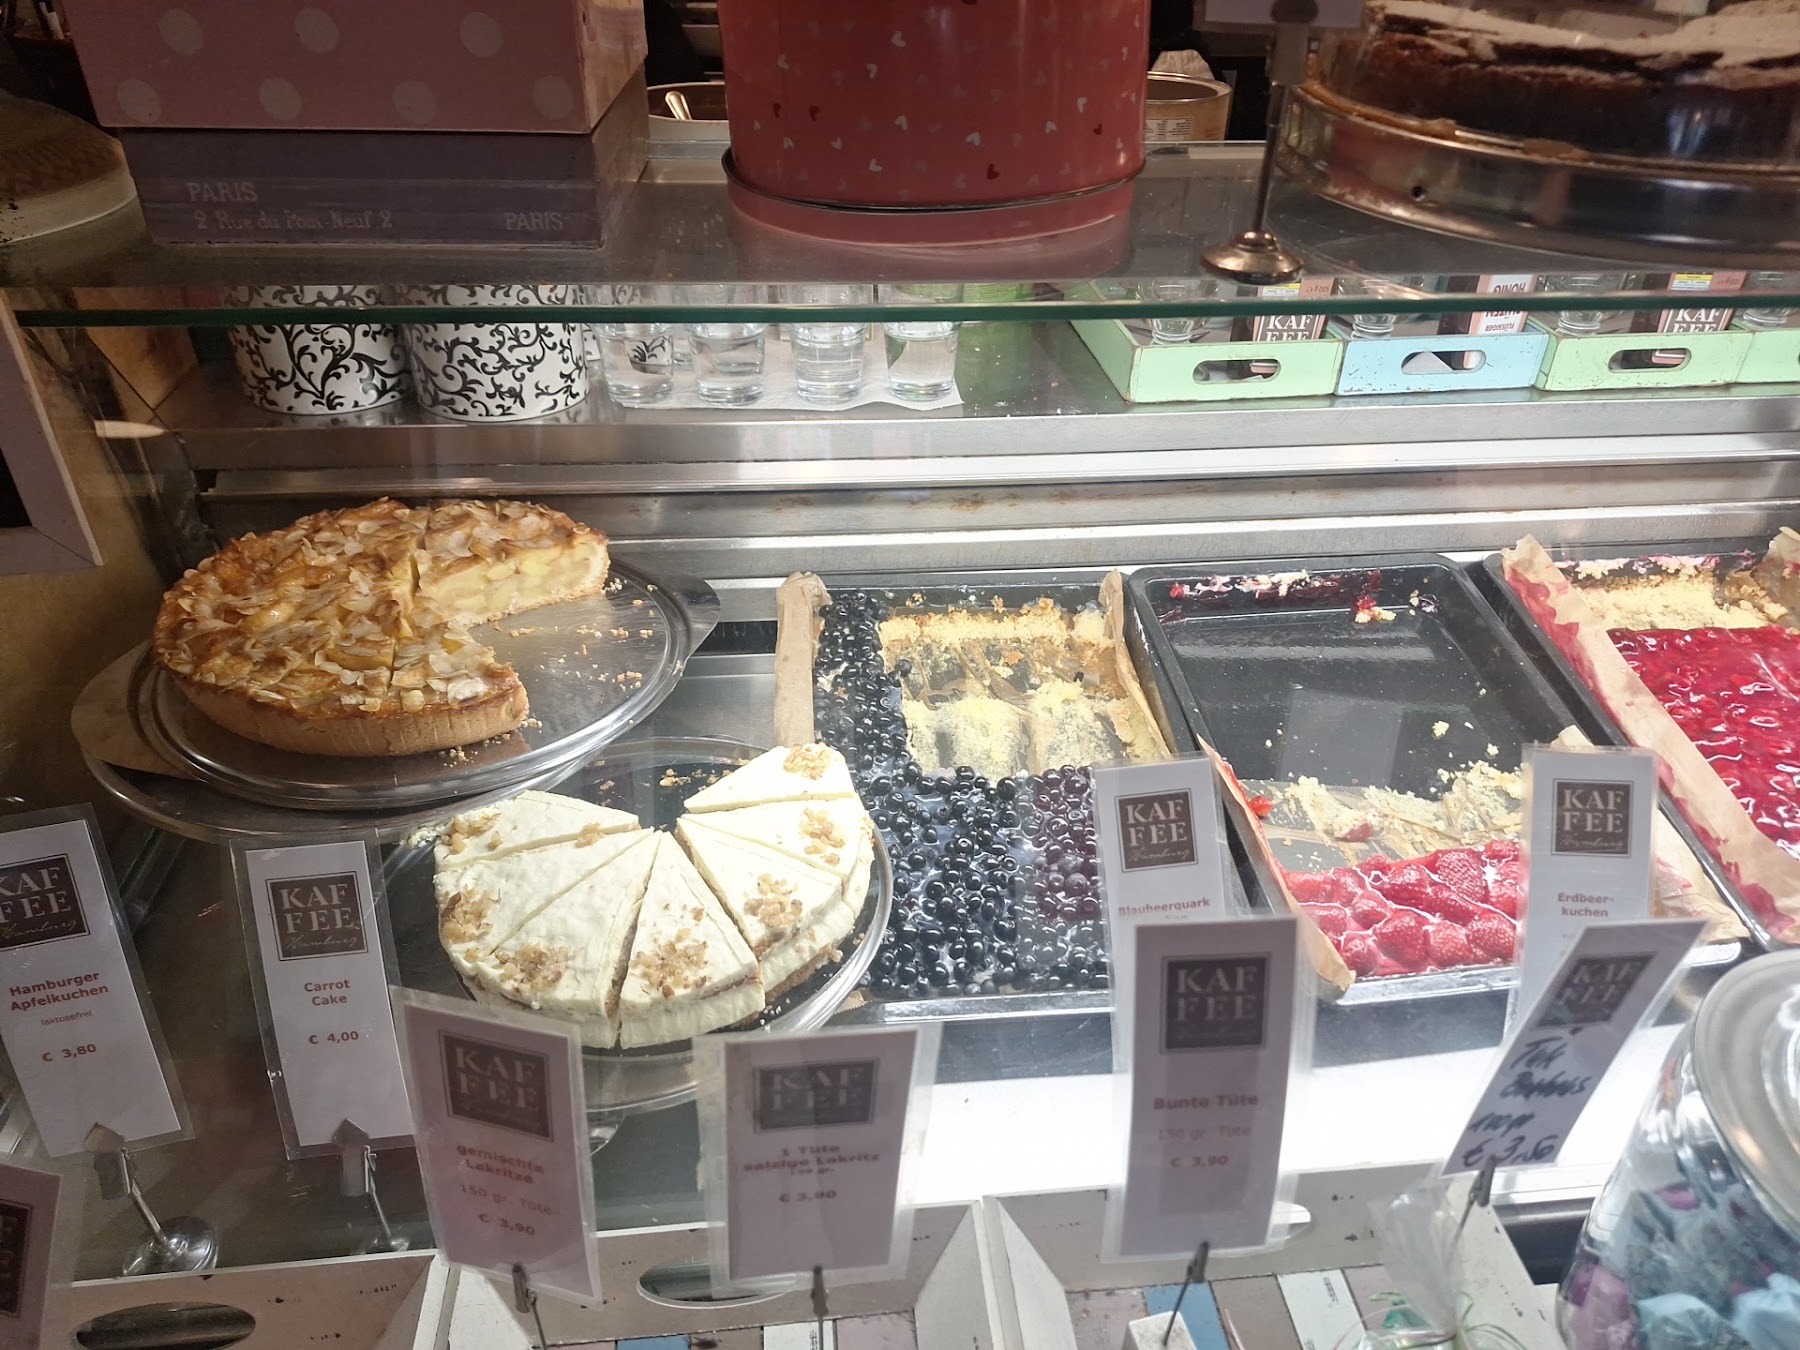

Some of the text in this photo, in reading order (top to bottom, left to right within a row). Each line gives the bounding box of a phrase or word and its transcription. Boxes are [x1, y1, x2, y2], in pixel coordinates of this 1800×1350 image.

[186, 182, 258, 201] PARIS
[258, 210, 281, 229] du
[380, 210, 393, 229] 2
[504, 211, 563, 232] PARIS
[1267, 315, 1313, 329] KAF
[1675, 308, 1720, 322] KAF
[1562, 788, 1625, 810] KAF
[1125, 799, 1184, 824] KAF
[1562, 811, 1624, 833] FEE
[1127, 822, 1188, 847] FEE
[280, 883, 348, 909] KAF
[1557, 892, 1615, 904] Erdbeer-
[1118, 897, 1211, 917] Blaubeerquark
[1561, 906, 1609, 918] kuchen
[283, 907, 354, 933] FEE
[9, 972, 100, 997] Hamburger
[304, 979, 351, 992] Carrot
[1176, 965, 1258, 993] KAF
[11, 985, 109, 1011] Apfelkuchen
[312, 995, 348, 1006] Cake
[1176, 994, 1258, 1021] FEE
[41, 1010, 93, 1026] laktosefrei
[327, 1030, 359, 1044] 4,00
[61, 1043, 97, 1058] 3,80
[456, 1047, 536, 1084] KAF
[457, 1071, 539, 1112] FEE
[1153, 1094, 1259, 1110] Bunte Tüte
[456, 1144, 545, 1174] gemischte
[816, 1153, 881, 1165] Lakritz
[464, 1158, 535, 1184] Lakritze
[460, 1183, 488, 1198] 150
